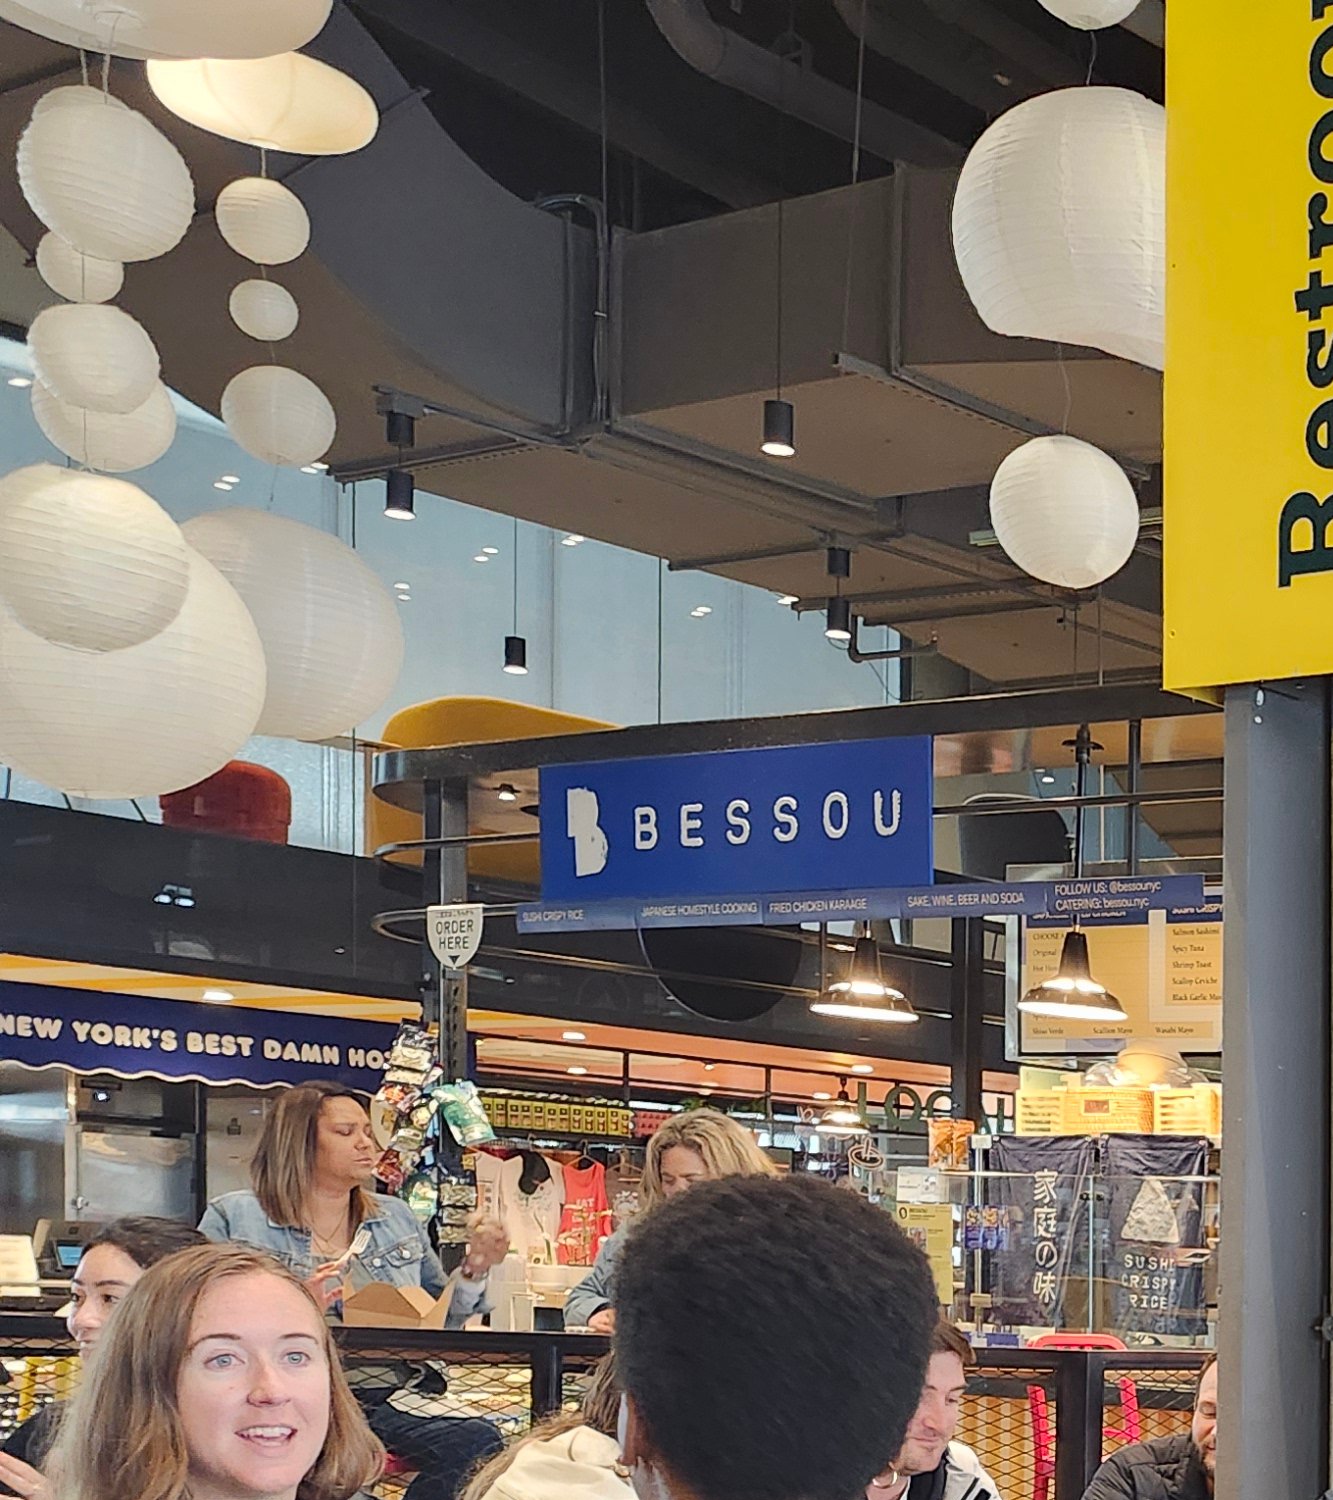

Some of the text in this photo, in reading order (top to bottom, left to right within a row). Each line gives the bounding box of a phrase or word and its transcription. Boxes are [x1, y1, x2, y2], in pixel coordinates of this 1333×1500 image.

[633, 789, 902, 851] BESSOU
[1055, 884, 1091, 896] FOLLOW
[1093, 882, 1107, 894] US:
[769, 898, 867, 913] FRIED CHICKEN KARAAGE
[958, 894, 980, 905] BEER
[981, 893, 999, 905] AND
[1000, 892, 1024, 903] SODA
[1055, 899, 1102, 911] CATERING:
[567, 909, 584, 920] RICE
[641, 902, 757, 917] JAPANESE HOMESTYLE COOKING
[435, 919, 474, 935] ORDER
[439, 936, 469, 949] HERE
[0, 1013, 391, 1070] NEW YORK'S BEST DAMN HO
[1032, 1168, 1060, 1306] 家庭の味
[1124, 1254, 1176, 1271] SUSHI
[1121, 1273, 1177, 1291] CRISPY
[1129, 1294, 1168, 1310] RICE
